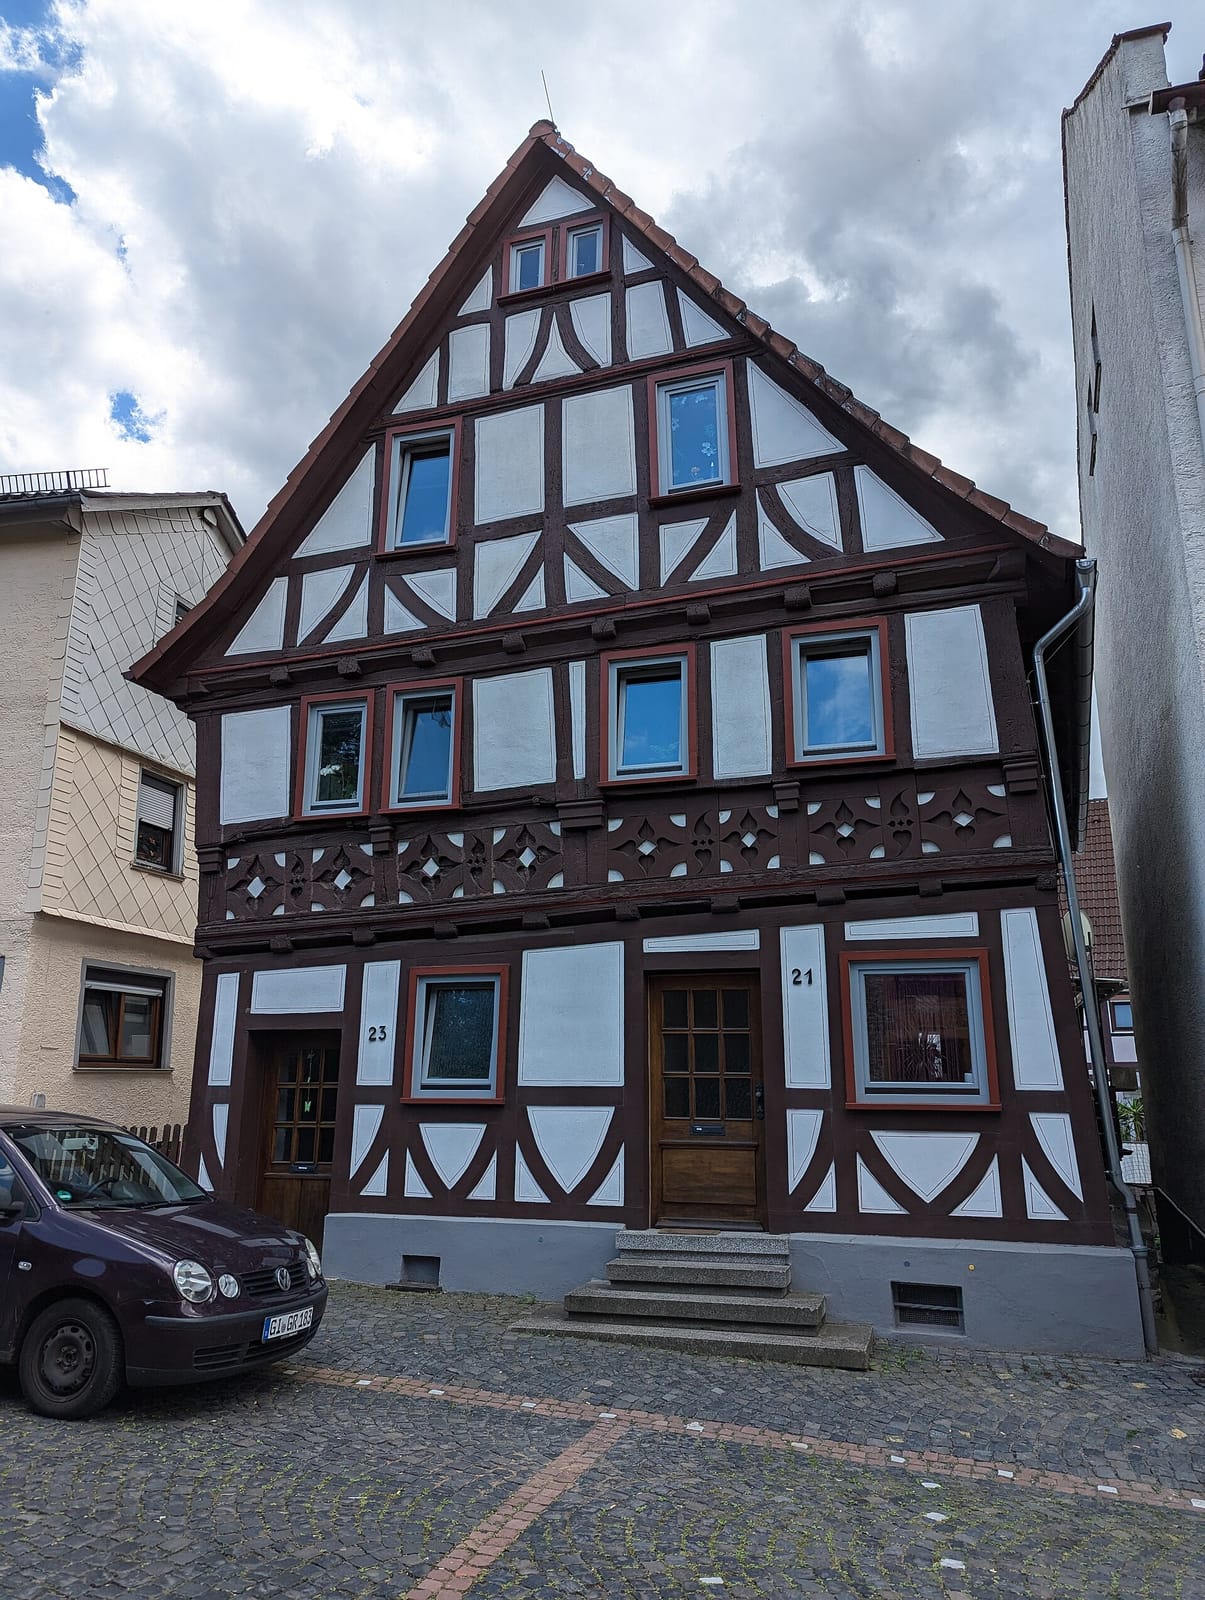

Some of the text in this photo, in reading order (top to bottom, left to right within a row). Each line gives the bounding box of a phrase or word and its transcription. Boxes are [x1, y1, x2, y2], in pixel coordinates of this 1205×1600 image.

[791, 967, 813, 985] 21
[368, 1025, 387, 1042] 23
[270, 1317, 281, 1336] GI
